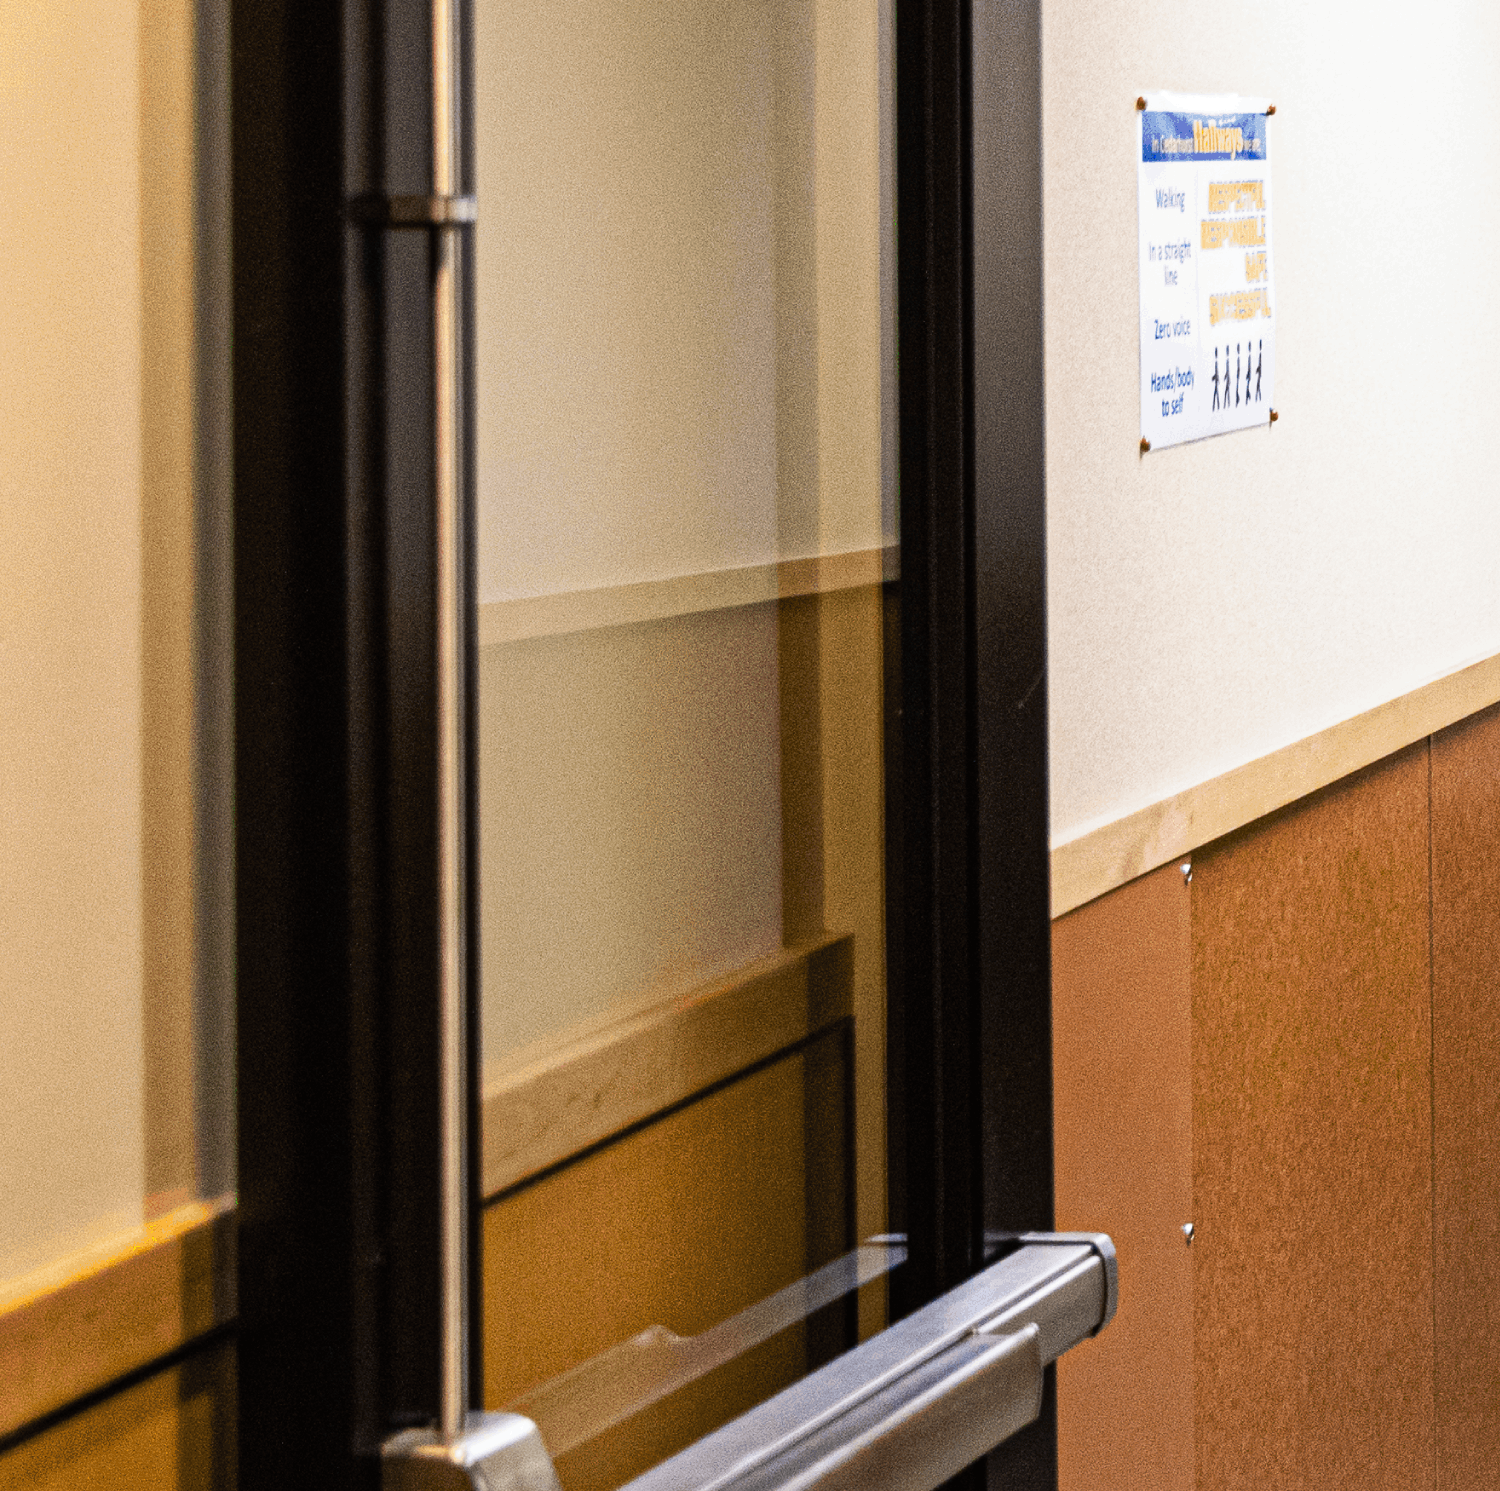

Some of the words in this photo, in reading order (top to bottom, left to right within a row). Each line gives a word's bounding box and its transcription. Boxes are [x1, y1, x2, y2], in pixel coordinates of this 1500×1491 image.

[1155, 187, 1185, 212] Walking
[1149, 242, 1156, 261] In
[1164, 237, 1192, 264] straight
[1164, 265, 1178, 285] line
[1154, 319, 1171, 339] Zero
[1173, 316, 1191, 336] voice
[1151, 366, 1194, 393] Hands/body
[1161, 399, 1170, 418] to
[1171, 391, 1185, 416] self
